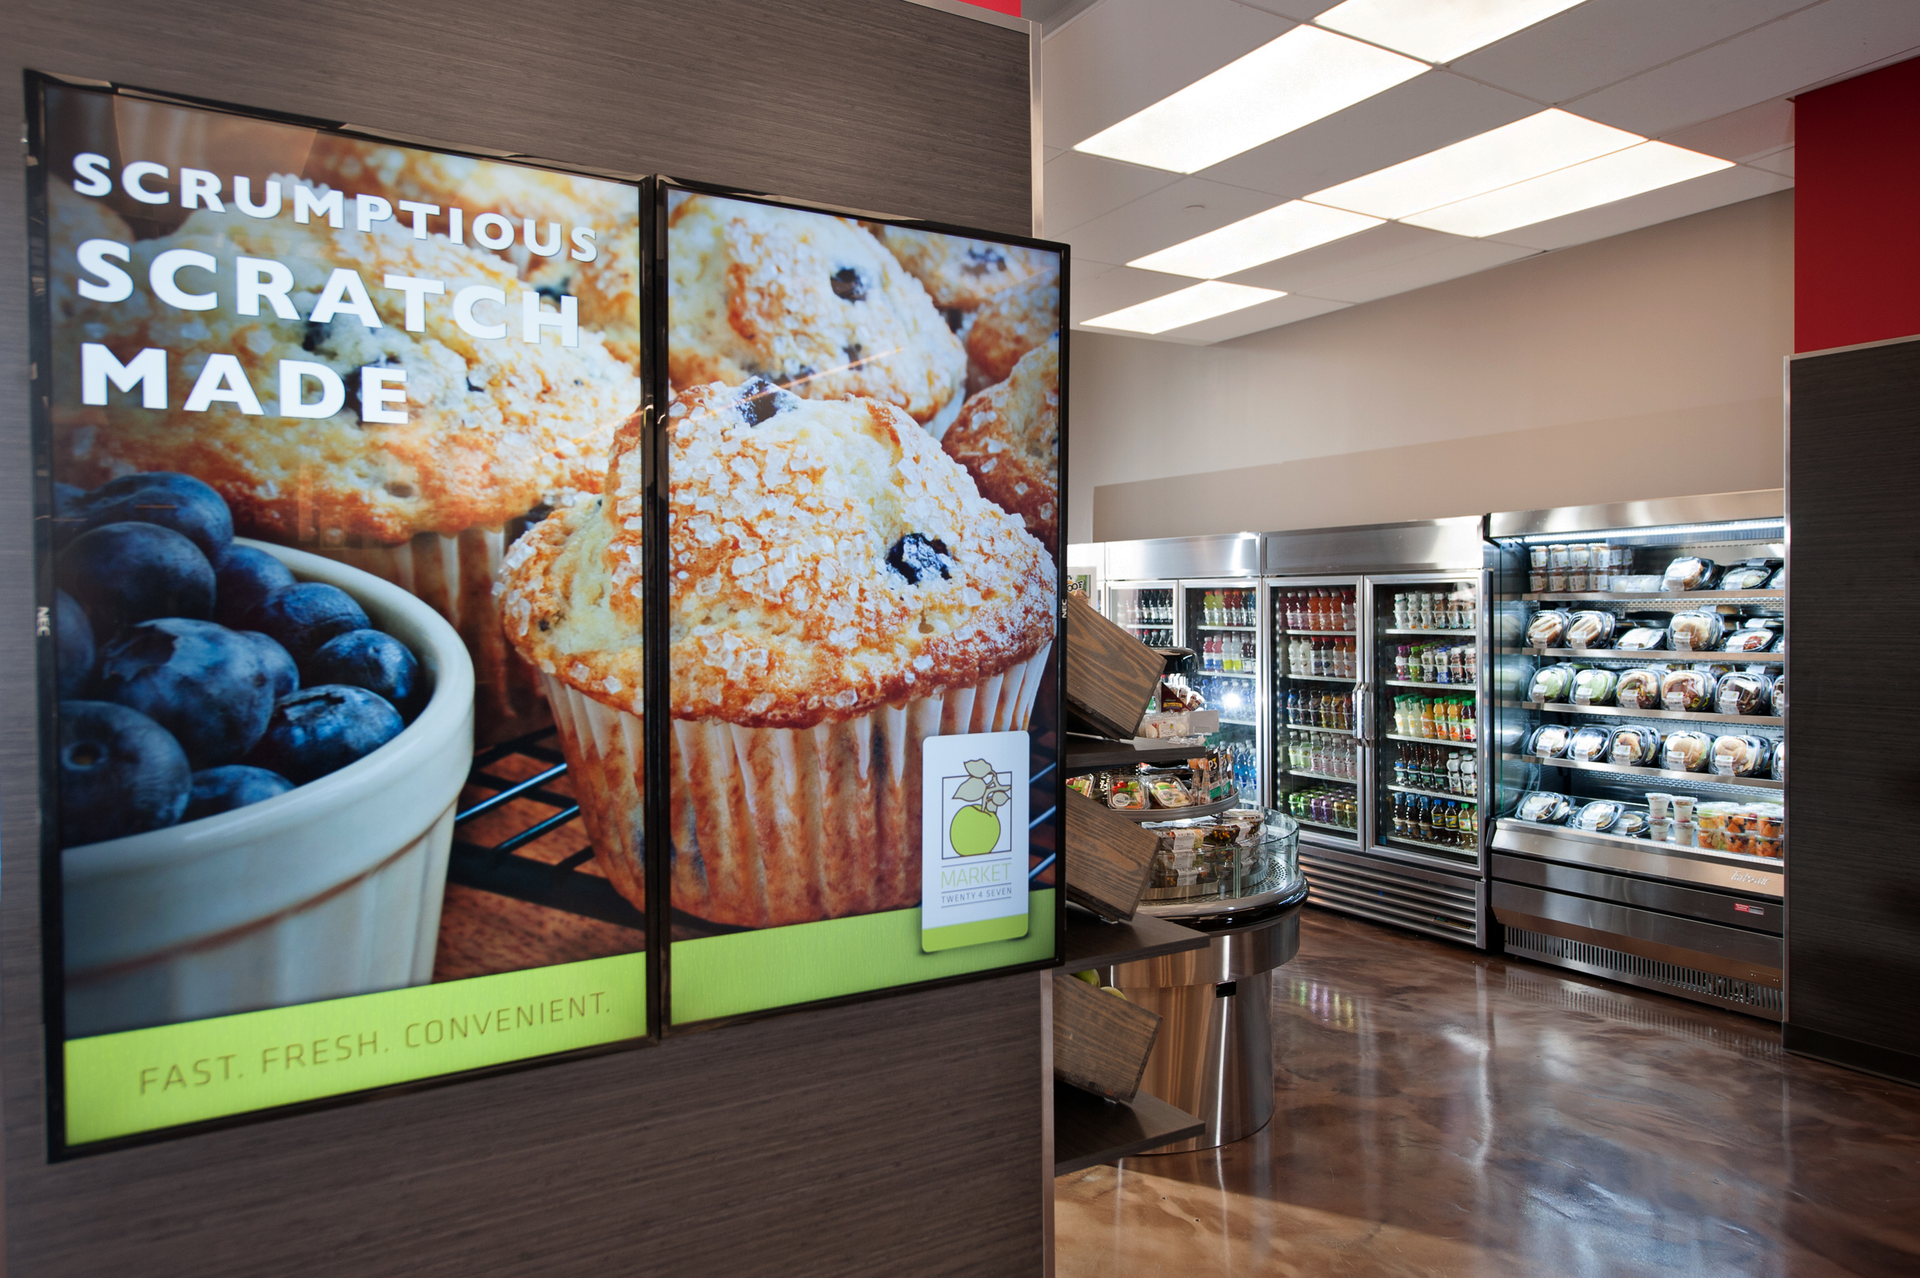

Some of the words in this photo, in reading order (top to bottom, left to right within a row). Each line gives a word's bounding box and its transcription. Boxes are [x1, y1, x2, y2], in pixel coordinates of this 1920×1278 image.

[72, 152, 599, 263] SCRUMPTIOUS
[76, 238, 580, 349] SCRATCH
[80, 342, 410, 425] MADE
[36, 605, 51, 637] NEC
[941, 863, 1011, 889] MARKET
[941, 891, 976, 904] TWENTY
[978, 890, 983, 898] 4
[986, 887, 1012, 898] SEVEN
[138, 1053, 244, 1097] FAST.
[261, 1030, 389, 1075] FRESH.
[404, 991, 611, 1049] CONVENIENT.
